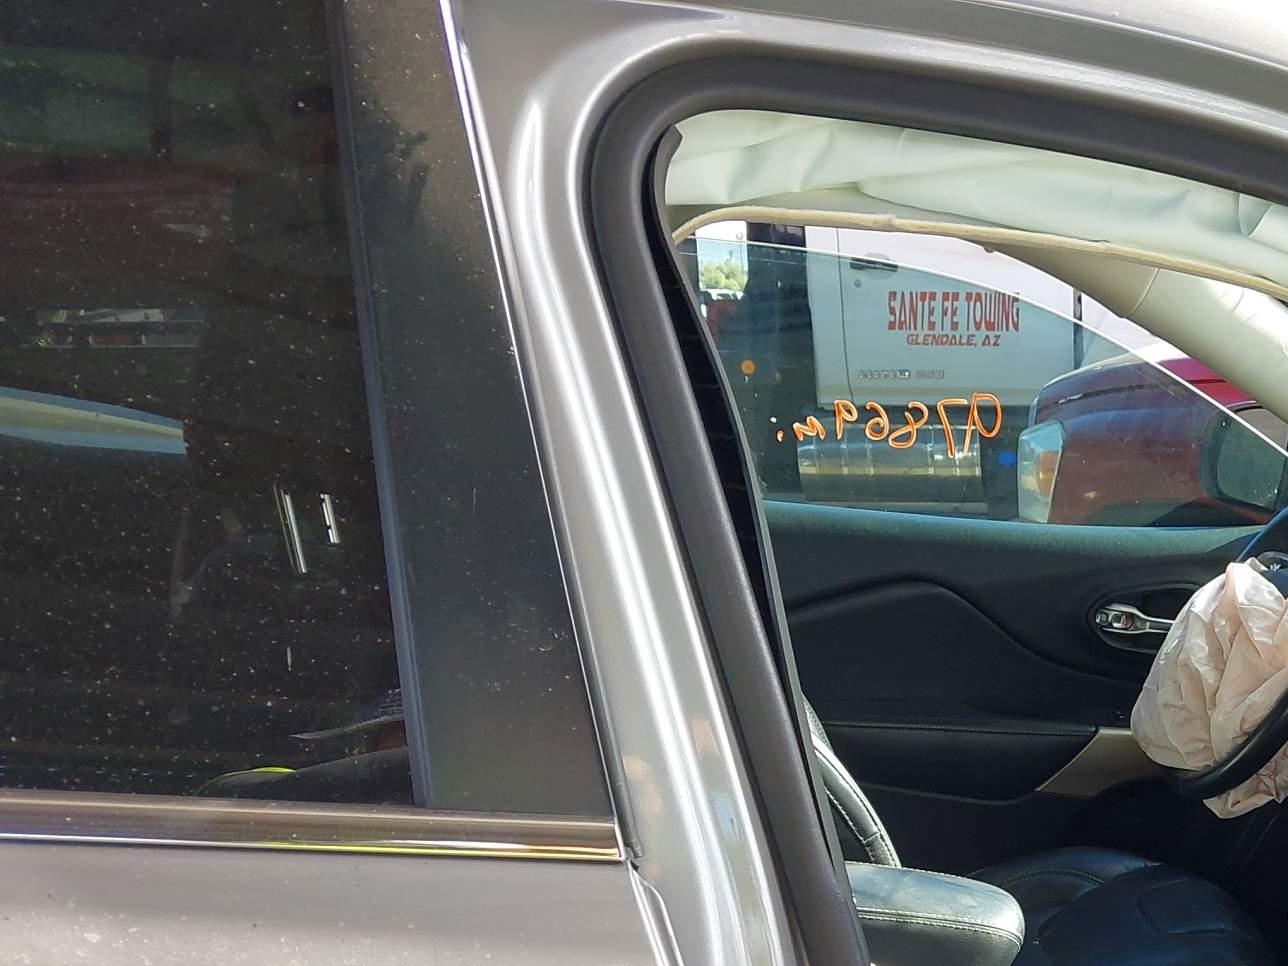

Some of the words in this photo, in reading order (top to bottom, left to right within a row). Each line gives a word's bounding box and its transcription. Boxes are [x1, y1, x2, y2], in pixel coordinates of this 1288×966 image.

[887, 290, 937, 332] SANTE
[941, 290, 960, 332] FE
[965, 290, 1020, 332] TOWING
[906, 333, 977, 348] GLENDALE,
[981, 334, 1001, 347] AZ
